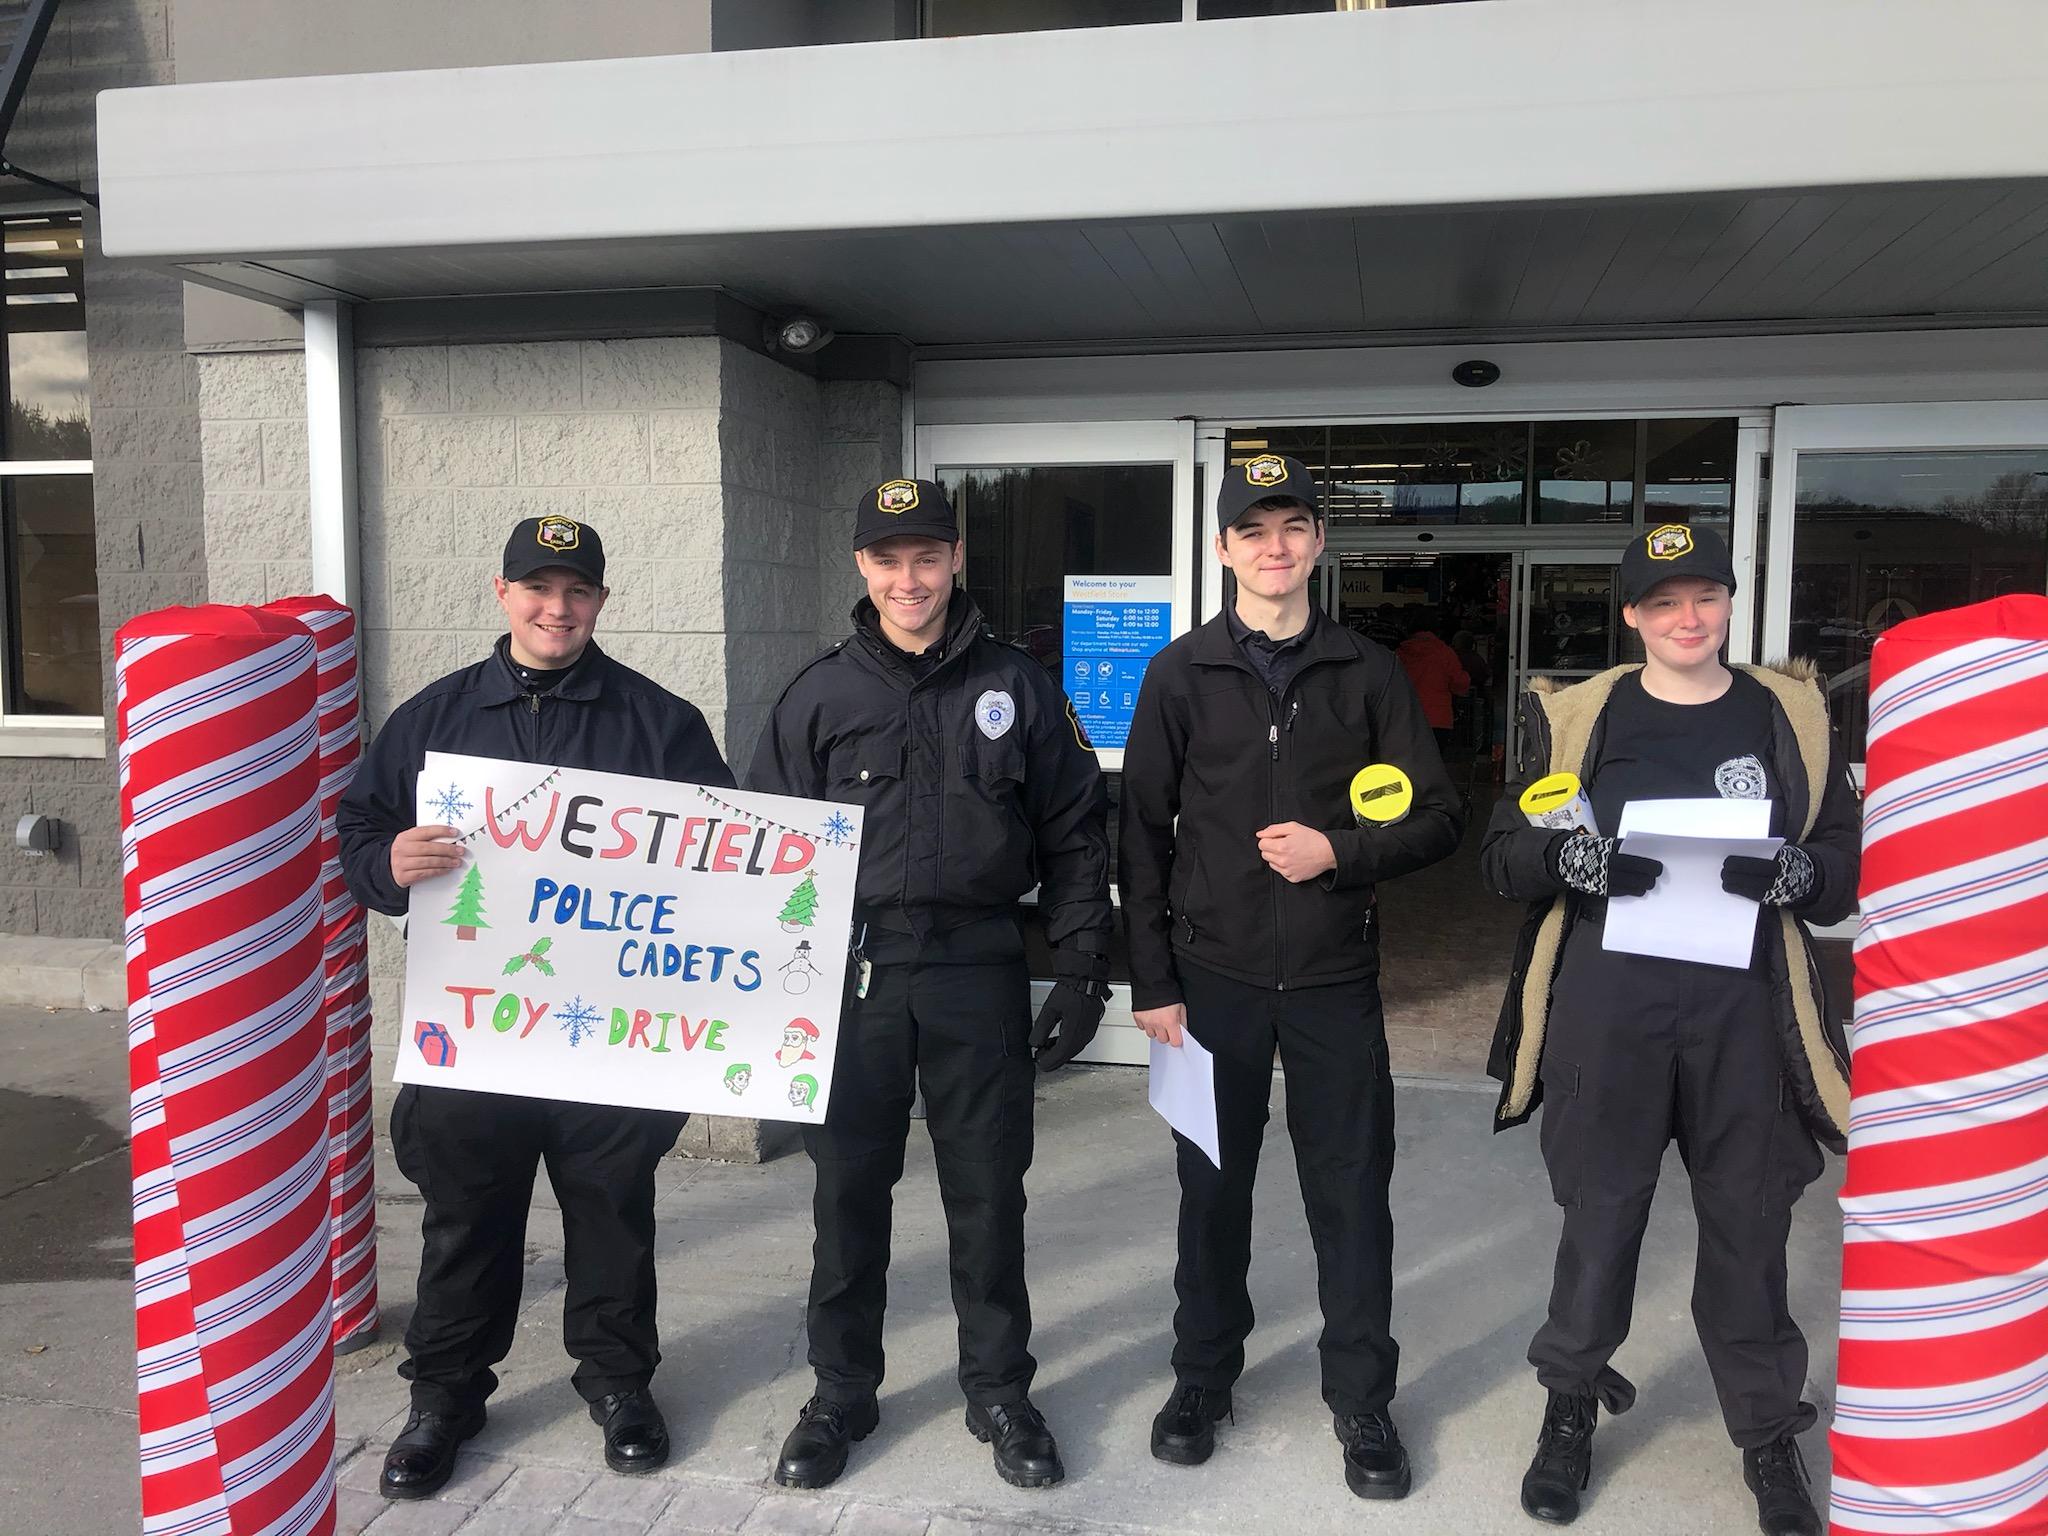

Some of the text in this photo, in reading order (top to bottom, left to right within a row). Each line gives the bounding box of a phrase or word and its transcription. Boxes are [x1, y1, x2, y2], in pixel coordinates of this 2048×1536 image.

[1072, 580, 1107, 588] Welcome
[1109, 580, 1117, 588] to
[1341, 580, 1372, 593] Milk
[1095, 615, 1120, 623] Saturday
[485, 786, 816, 876] WESTFIELD
[529, 877, 678, 934] POLICE
[618, 939, 762, 991] CADETS
[445, 985, 730, 1052] TOY DRIVE
